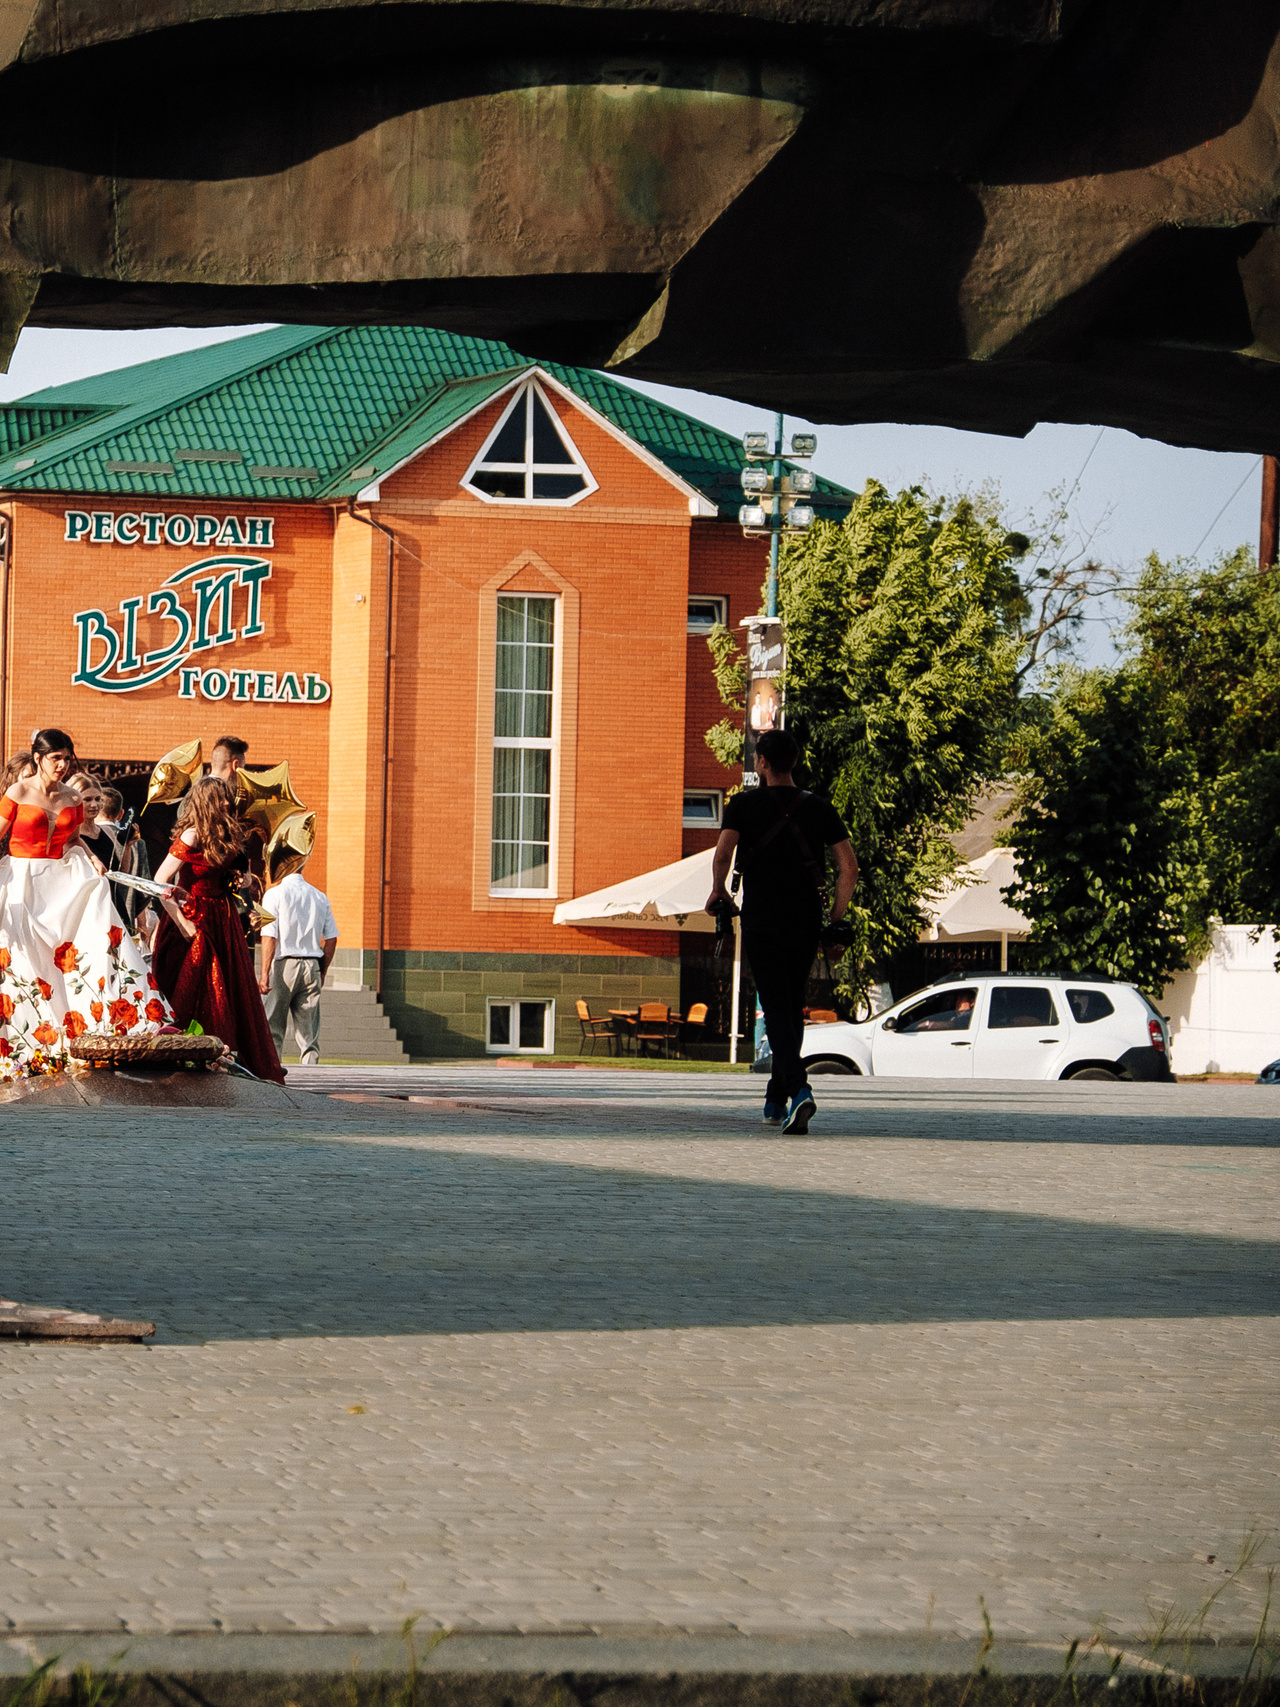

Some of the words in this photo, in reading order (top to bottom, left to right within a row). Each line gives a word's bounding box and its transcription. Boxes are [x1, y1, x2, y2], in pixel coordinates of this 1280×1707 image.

[64, 510, 275, 548] РЕСТОРАН
[71, 554, 273, 693] ВІЗИТ
[178, 666, 332, 704] ГОТЕЛЬ
